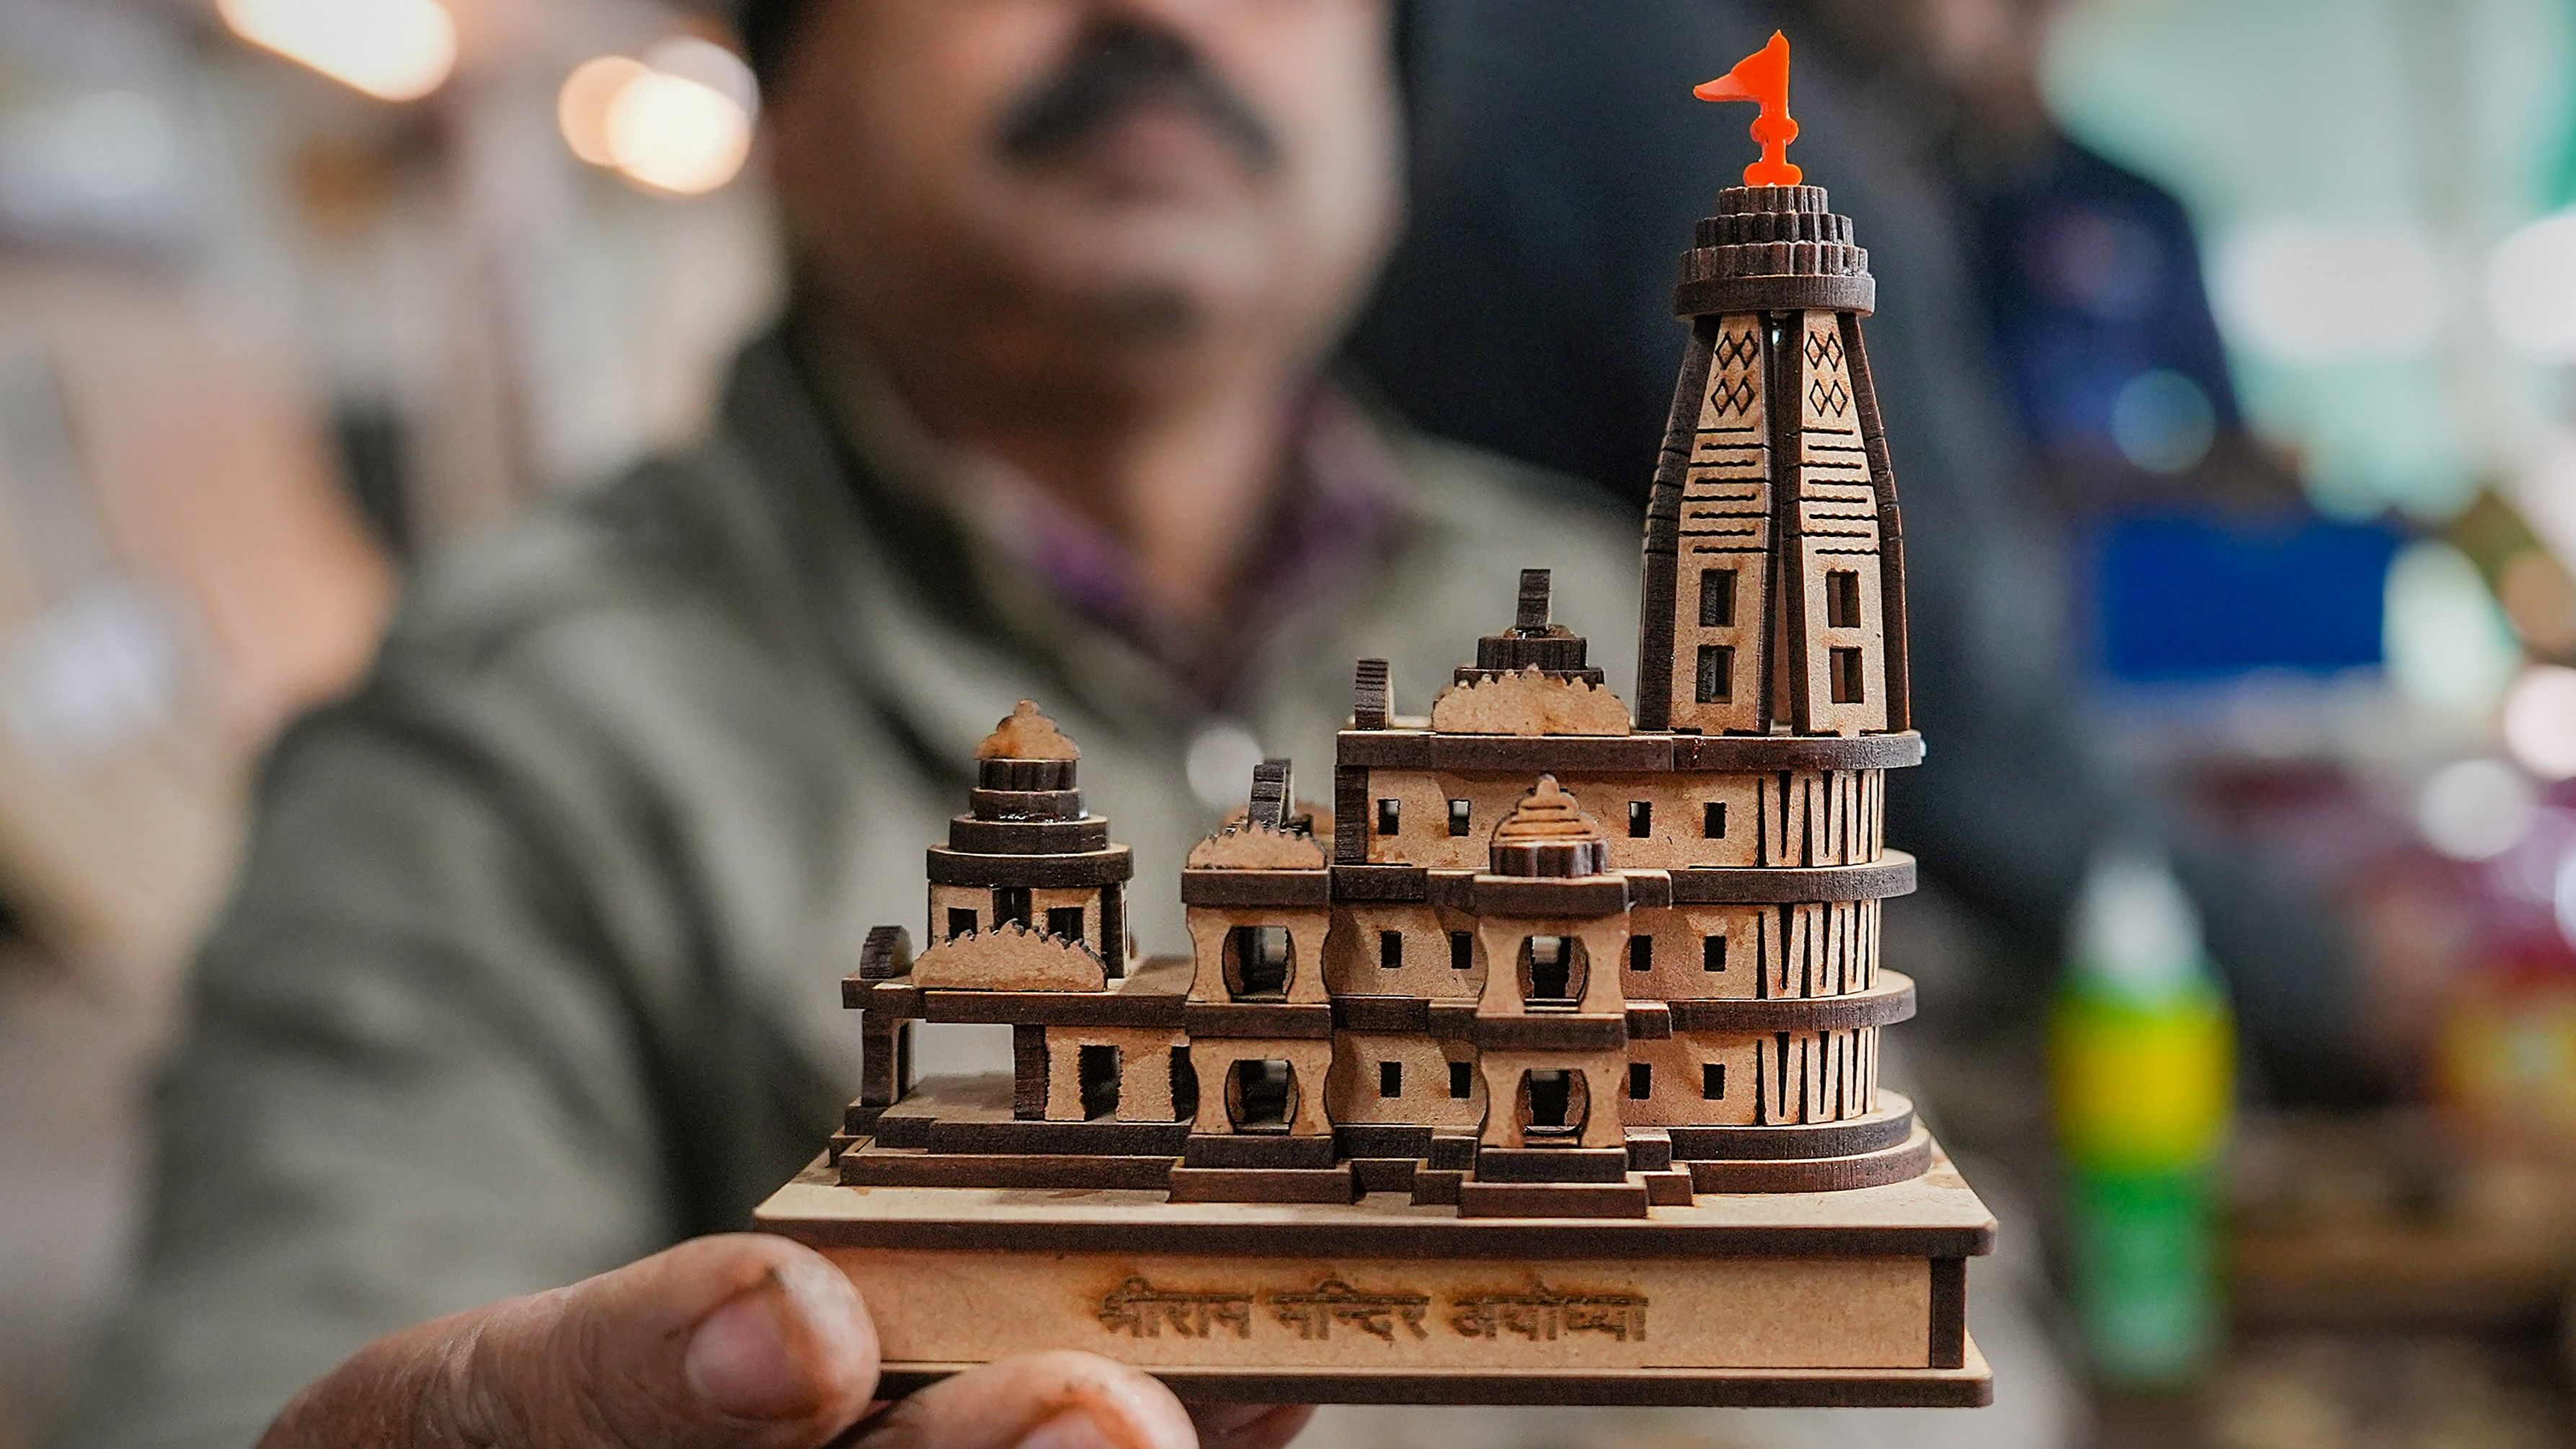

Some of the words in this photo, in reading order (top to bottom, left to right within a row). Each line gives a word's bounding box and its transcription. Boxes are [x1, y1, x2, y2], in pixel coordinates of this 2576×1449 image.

[1098, 1275, 1253, 1339] श्रीराम
[1268, 1279, 1431, 1347] मन्दिर
[1451, 1280, 1649, 1342] अयोध्या
